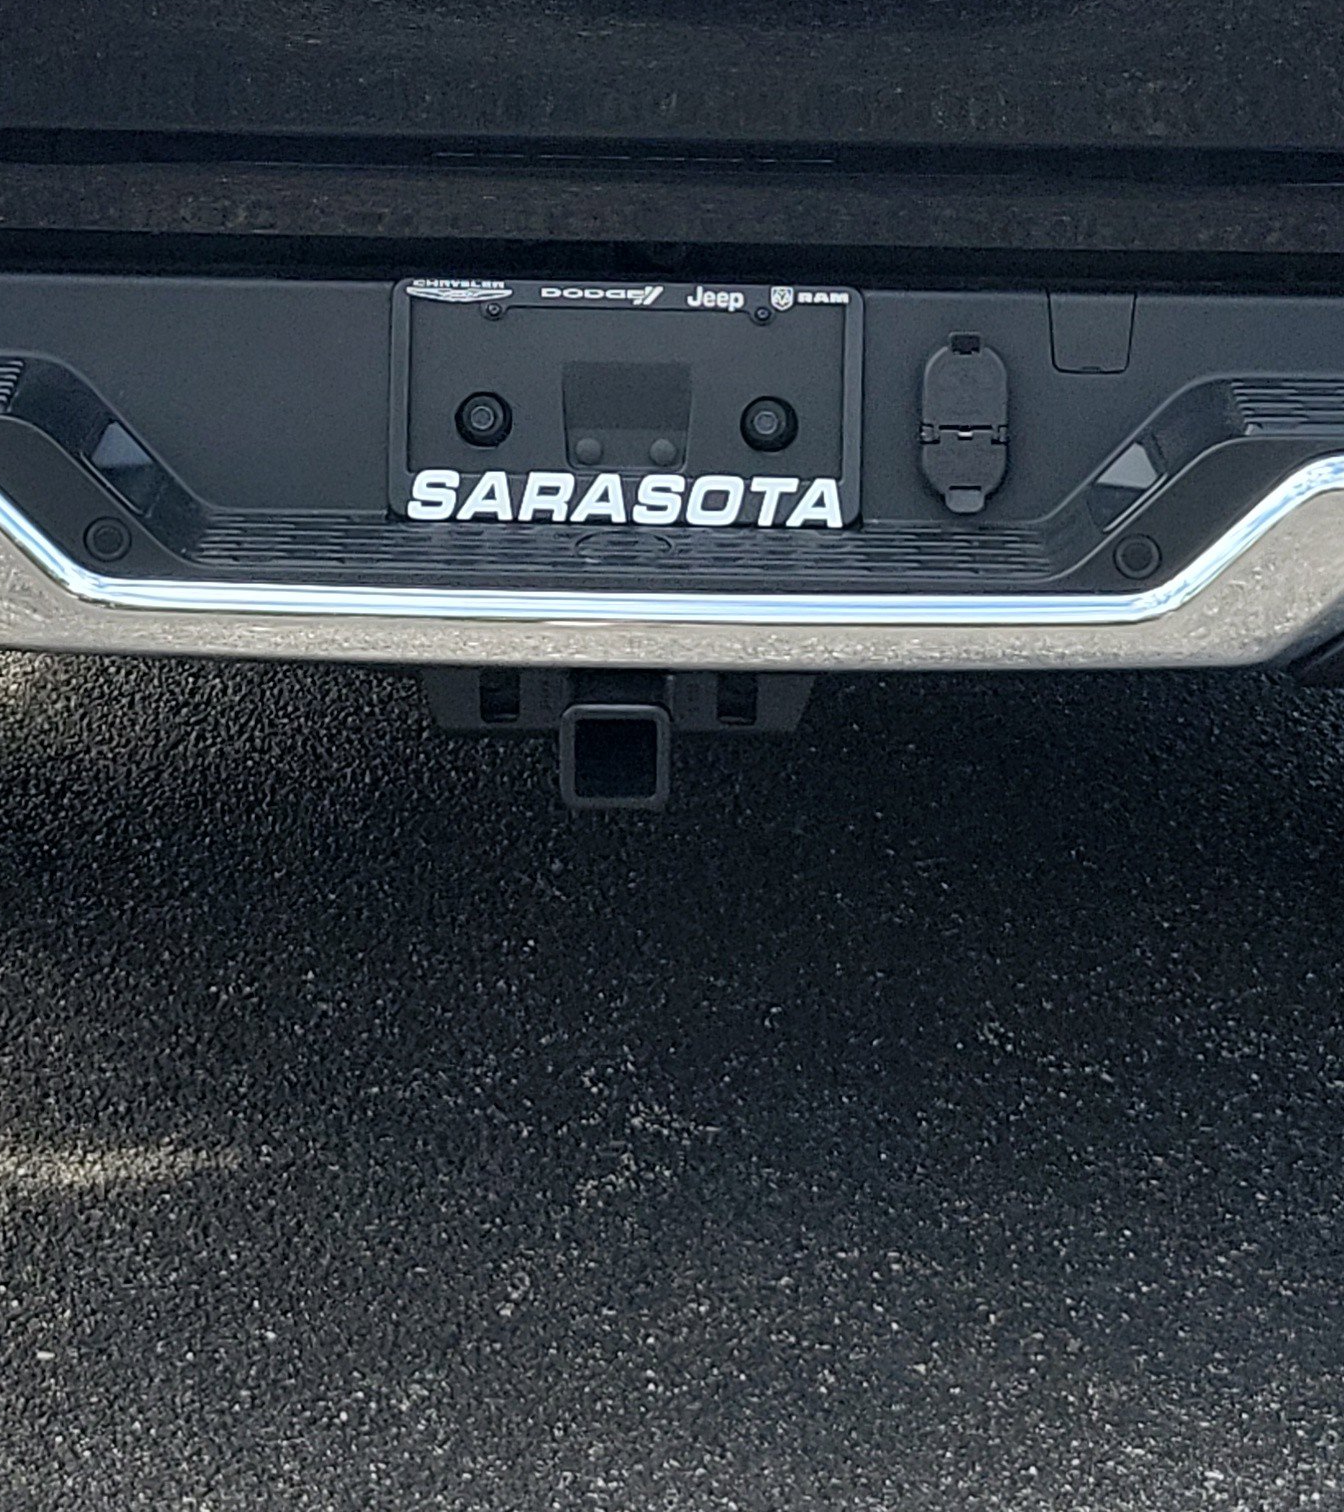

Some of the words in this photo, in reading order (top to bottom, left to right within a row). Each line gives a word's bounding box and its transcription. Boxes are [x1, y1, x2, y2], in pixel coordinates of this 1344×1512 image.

[540, 287, 645, 301] DODGE
[686, 285, 745, 312] Jeep
[797, 291, 850, 304] RAM
[406, 468, 844, 529] SARASOTA
